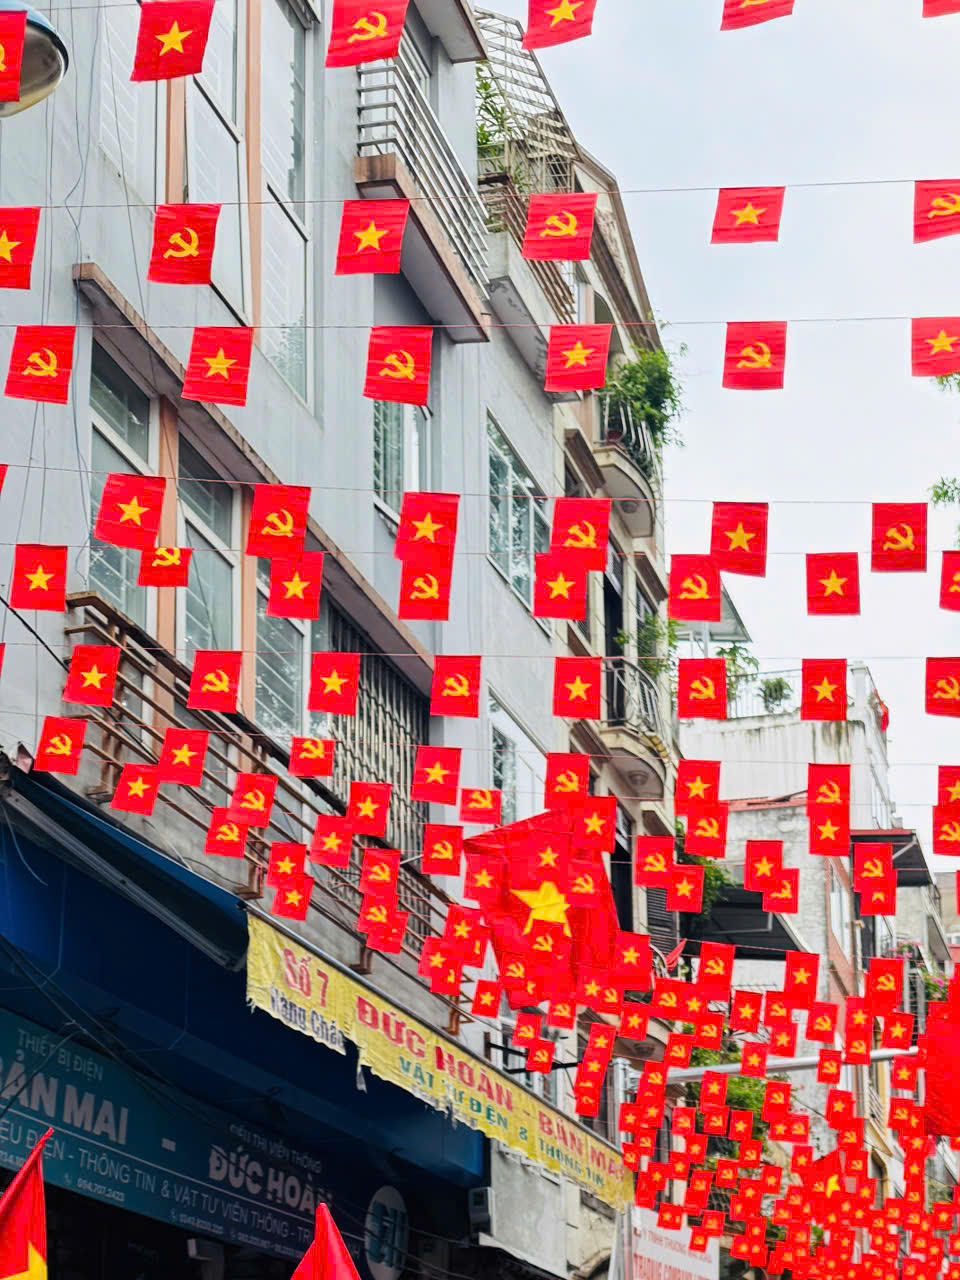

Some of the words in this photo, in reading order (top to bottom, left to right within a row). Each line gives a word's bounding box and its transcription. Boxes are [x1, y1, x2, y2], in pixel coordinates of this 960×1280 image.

[316, 968, 328, 1008] 7
[357, 996, 427, 1059] ĐỨC
[0, 1048, 59, 1119] ẢN
[63, 1084, 129, 1145] MAI
[78, 1147, 130, 1184] THÔNG
[133, 1169, 157, 1193] TIN
[160, 1179, 170, 1198] &
[174, 1184, 199, 1211] VẬT
[208, 1143, 263, 1195] ĐỨC
